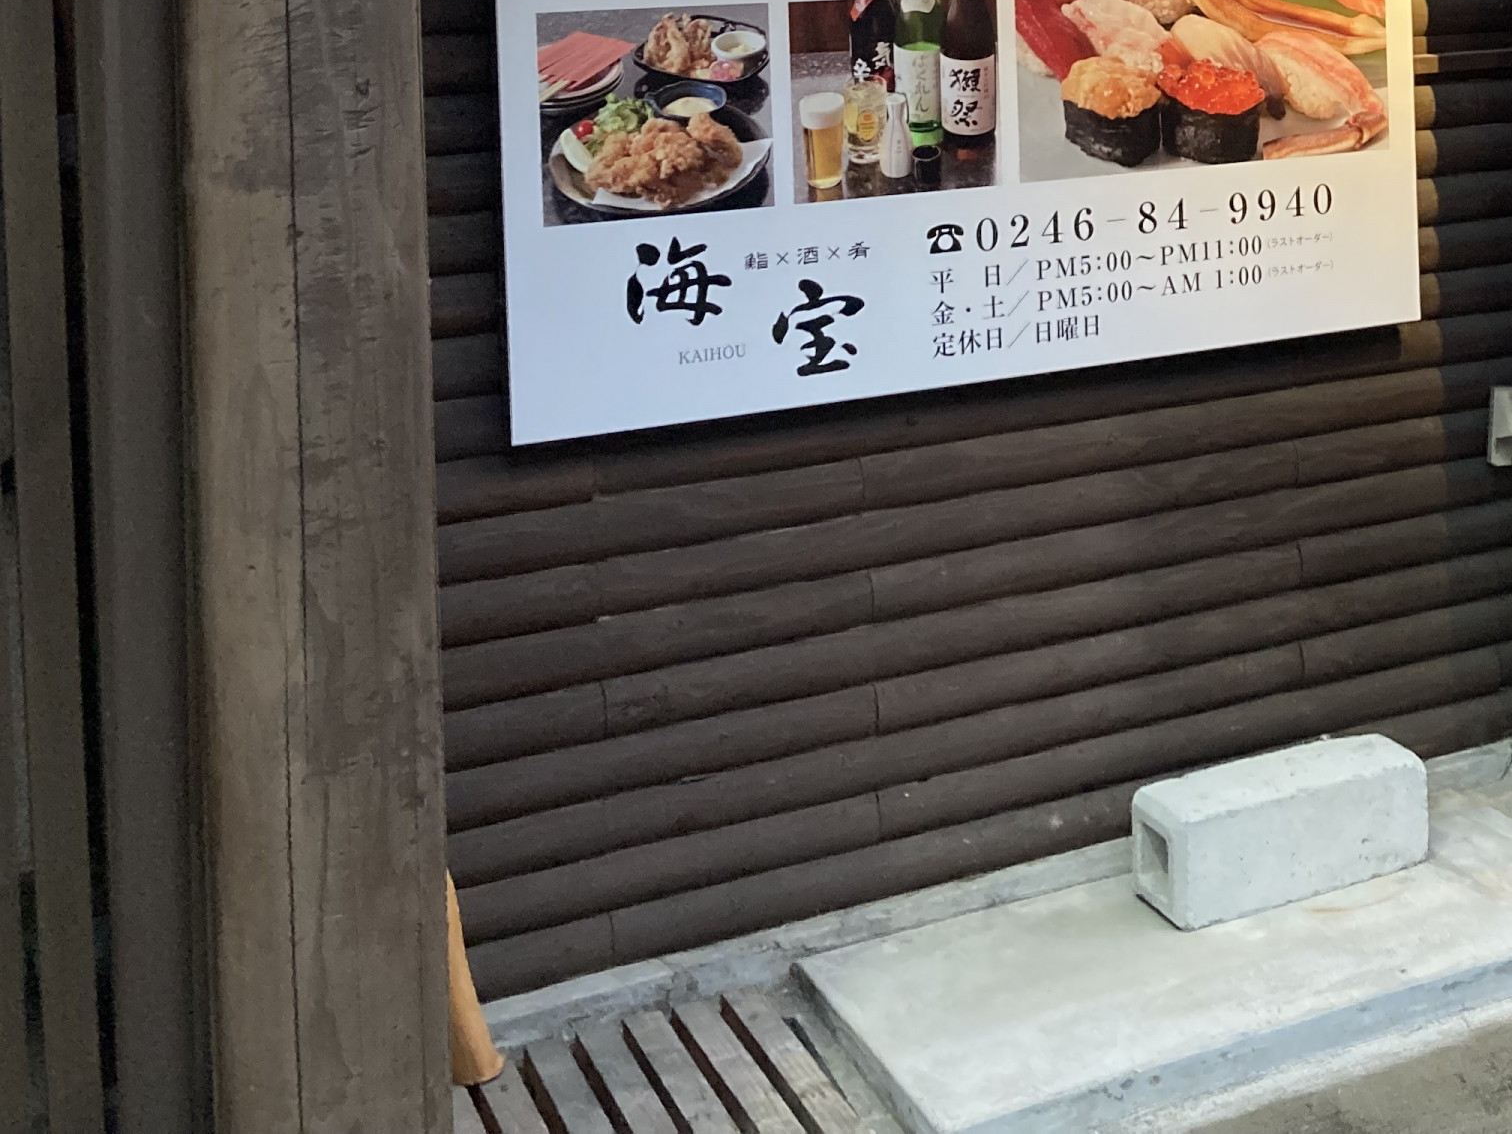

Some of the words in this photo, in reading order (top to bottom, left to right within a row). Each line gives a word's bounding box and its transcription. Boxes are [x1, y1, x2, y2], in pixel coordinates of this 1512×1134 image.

[744, 241, 871, 271] 鮨×酒×肴
[678, 343, 747, 365] KAIHOU
